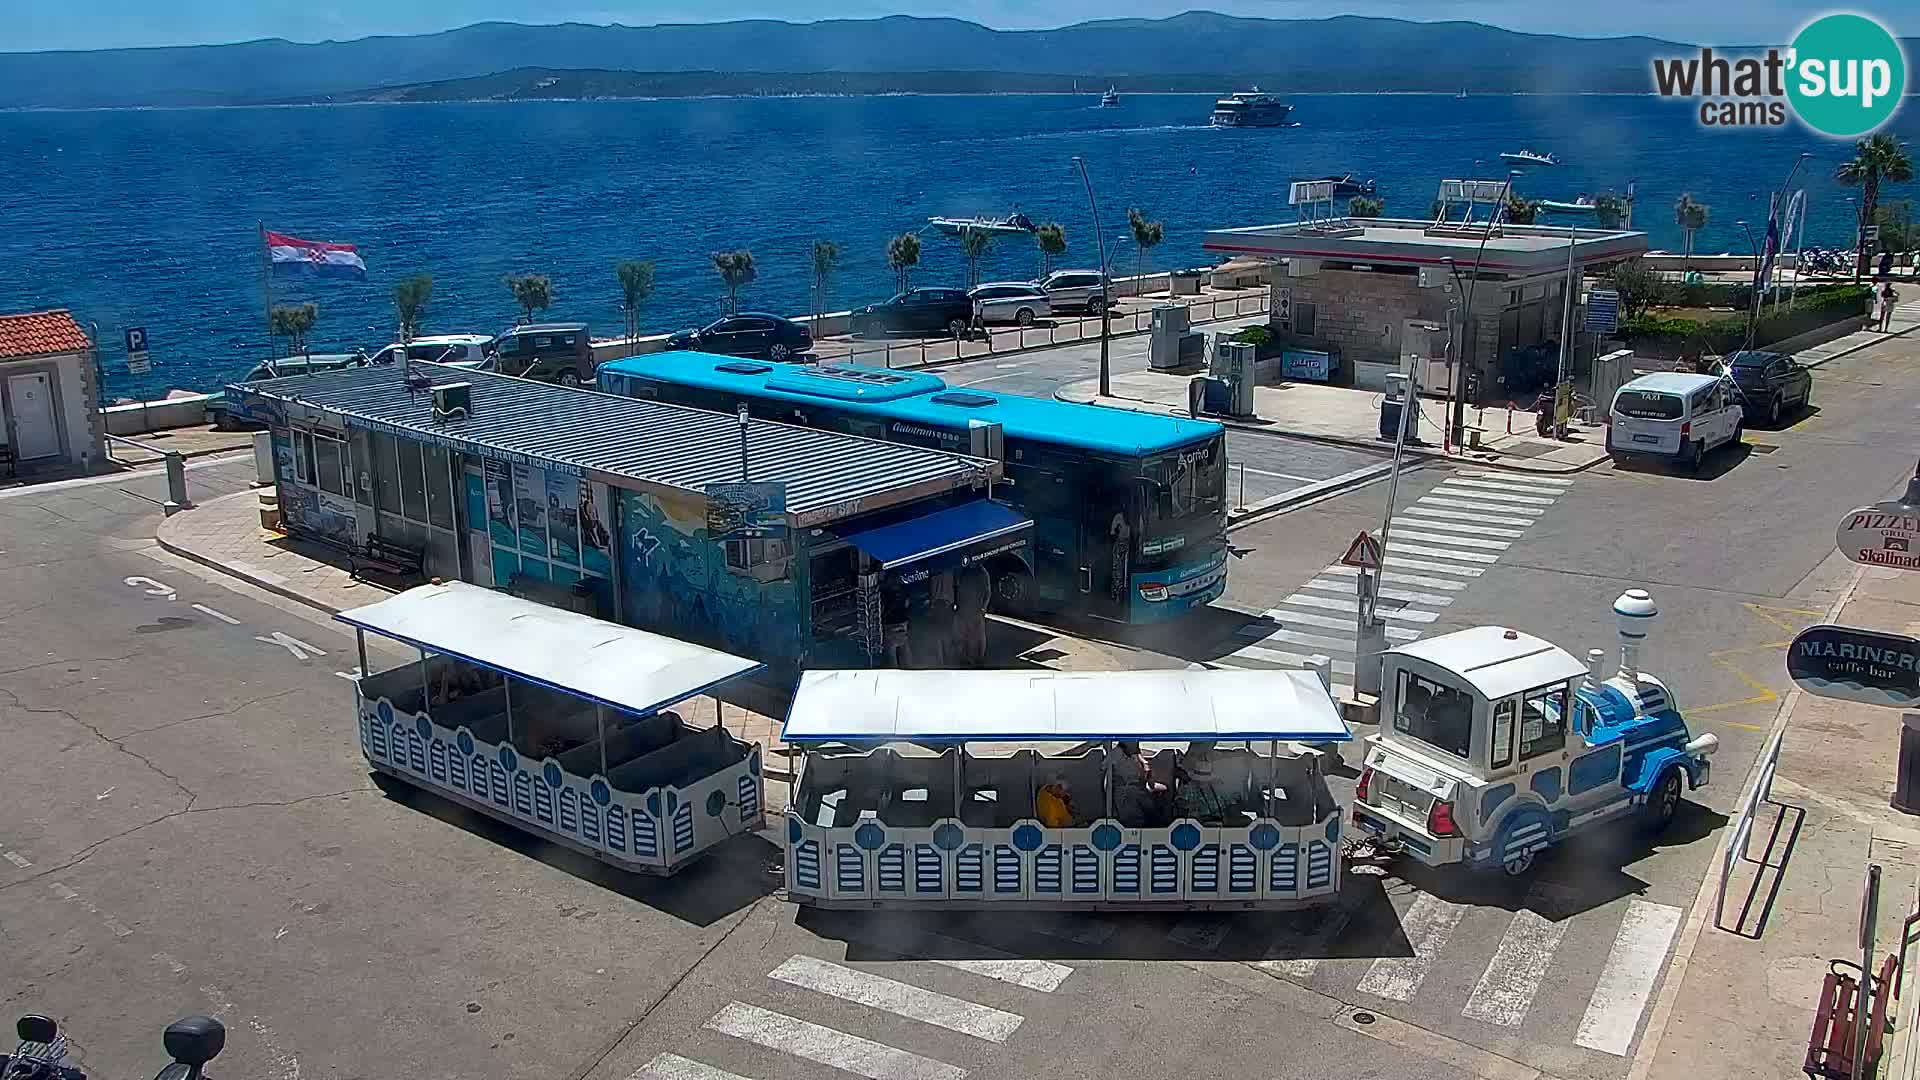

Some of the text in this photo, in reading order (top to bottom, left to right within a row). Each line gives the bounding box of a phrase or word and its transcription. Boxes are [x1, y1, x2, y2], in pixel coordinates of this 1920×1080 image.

[130, 331, 142, 349] P
[1641, 391, 1660, 401] TAXI
[478, 445, 492, 457] BUS
[494, 450, 526, 464] STATION
[528, 457, 553, 472] TICKET
[554, 463, 582, 478] OFFICE
[1869, 664, 1896, 679] bar
